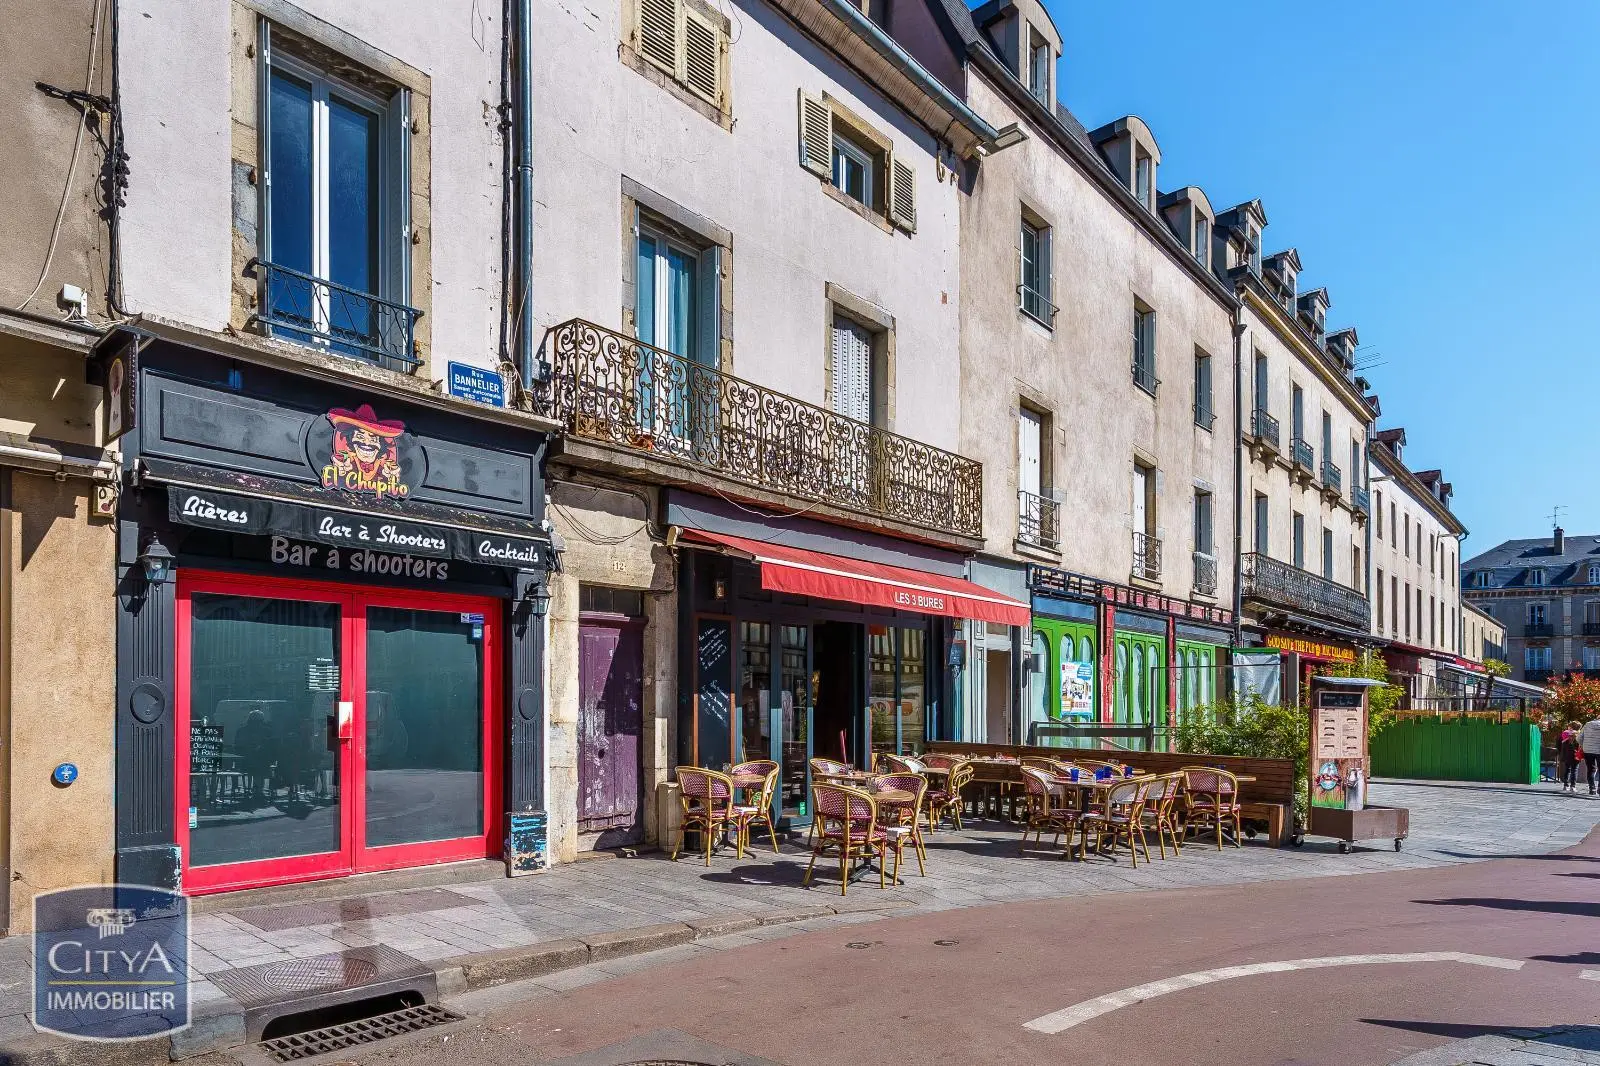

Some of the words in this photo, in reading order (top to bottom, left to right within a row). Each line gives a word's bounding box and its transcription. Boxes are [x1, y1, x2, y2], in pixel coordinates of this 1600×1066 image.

[454, 374, 500, 394] BANNELIER
[471, 370, 484, 379] Rue
[322, 465, 338, 487] El
[345, 471, 409, 499] Chupito
[182, 495, 248, 524] Bières
[318, 516, 352, 538] Bar
[358, 524, 370, 541] à
[376, 524, 446, 550] Shooters
[271, 535, 317, 567] Bar
[350, 551, 449, 580] shooters
[478, 540, 539, 563] Cocktails
[616, 561, 625, 571] 12
[894, 591, 910, 605] LES
[911, 594, 917, 606] 3
[917, 595, 944, 610] BURES
[1295, 640, 1305, 652] THE
